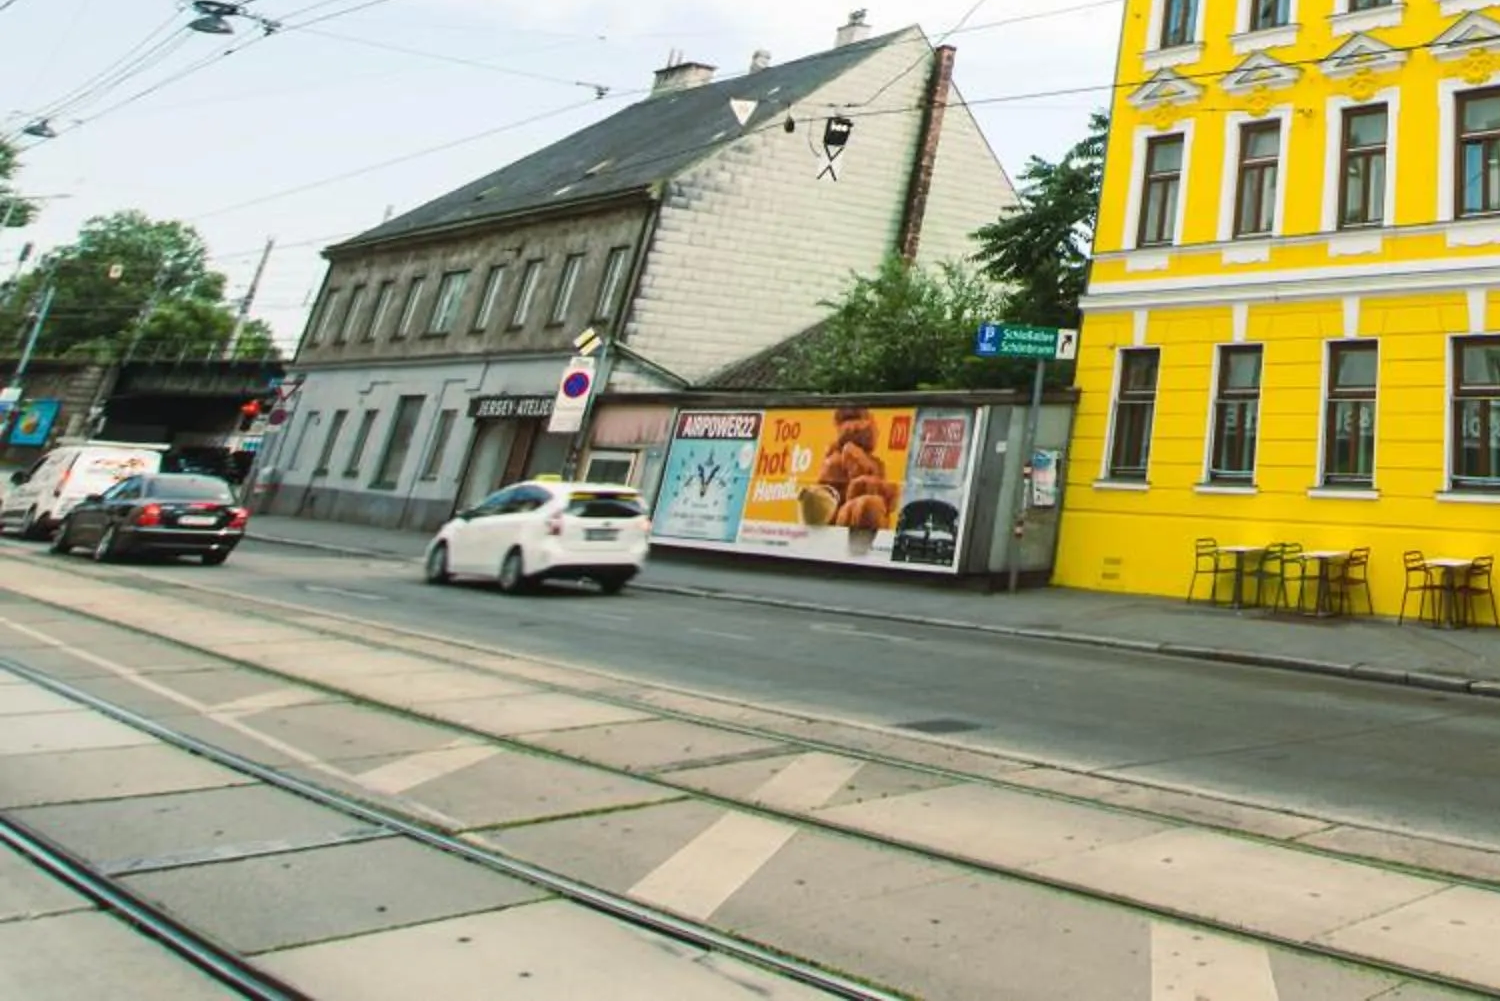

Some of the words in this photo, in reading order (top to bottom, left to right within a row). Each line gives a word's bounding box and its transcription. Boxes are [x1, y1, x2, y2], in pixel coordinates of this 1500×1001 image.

[681, 415, 757, 438] AIRPOWER22
[773, 418, 801, 443] Too
[756, 446, 789, 476] hot
[791, 444, 813, 473] to
